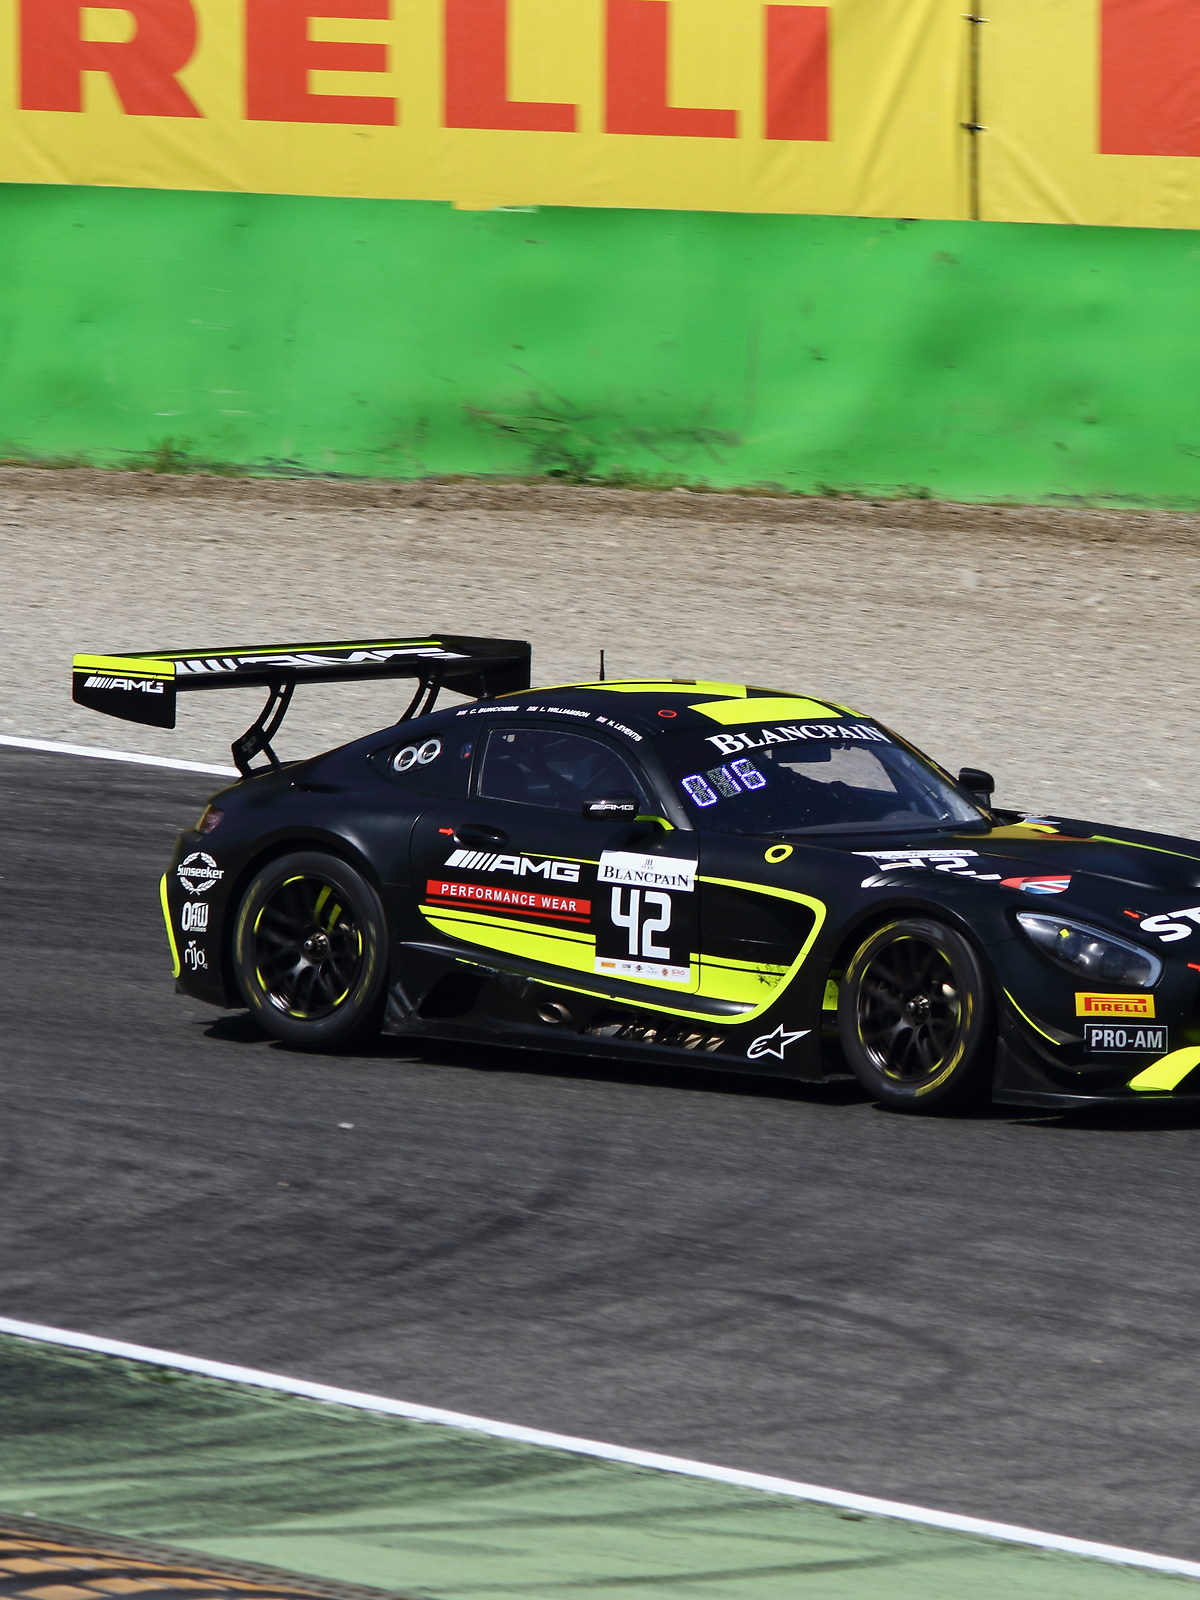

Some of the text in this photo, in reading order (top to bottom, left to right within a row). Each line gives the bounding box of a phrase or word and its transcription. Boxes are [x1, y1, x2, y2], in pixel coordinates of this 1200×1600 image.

[477, 705, 520, 714] BUNCOMBE
[547, 707, 591, 718] WILLIAMSON
[613, 722, 643, 742] LEVENTIS
[705, 724, 892, 756] BLANCPAIN
[176, 864, 225, 880] Sunseeker
[489, 855, 581, 883] AMG
[603, 865, 689, 887] BLANCPAIN
[441, 883, 577, 912] PERFORMANCE WEAR
[611, 886, 672, 960] 42
[1084, 996, 1148, 1014] PIRELLI
[1090, 1028, 1163, 1050] PRO-AM
